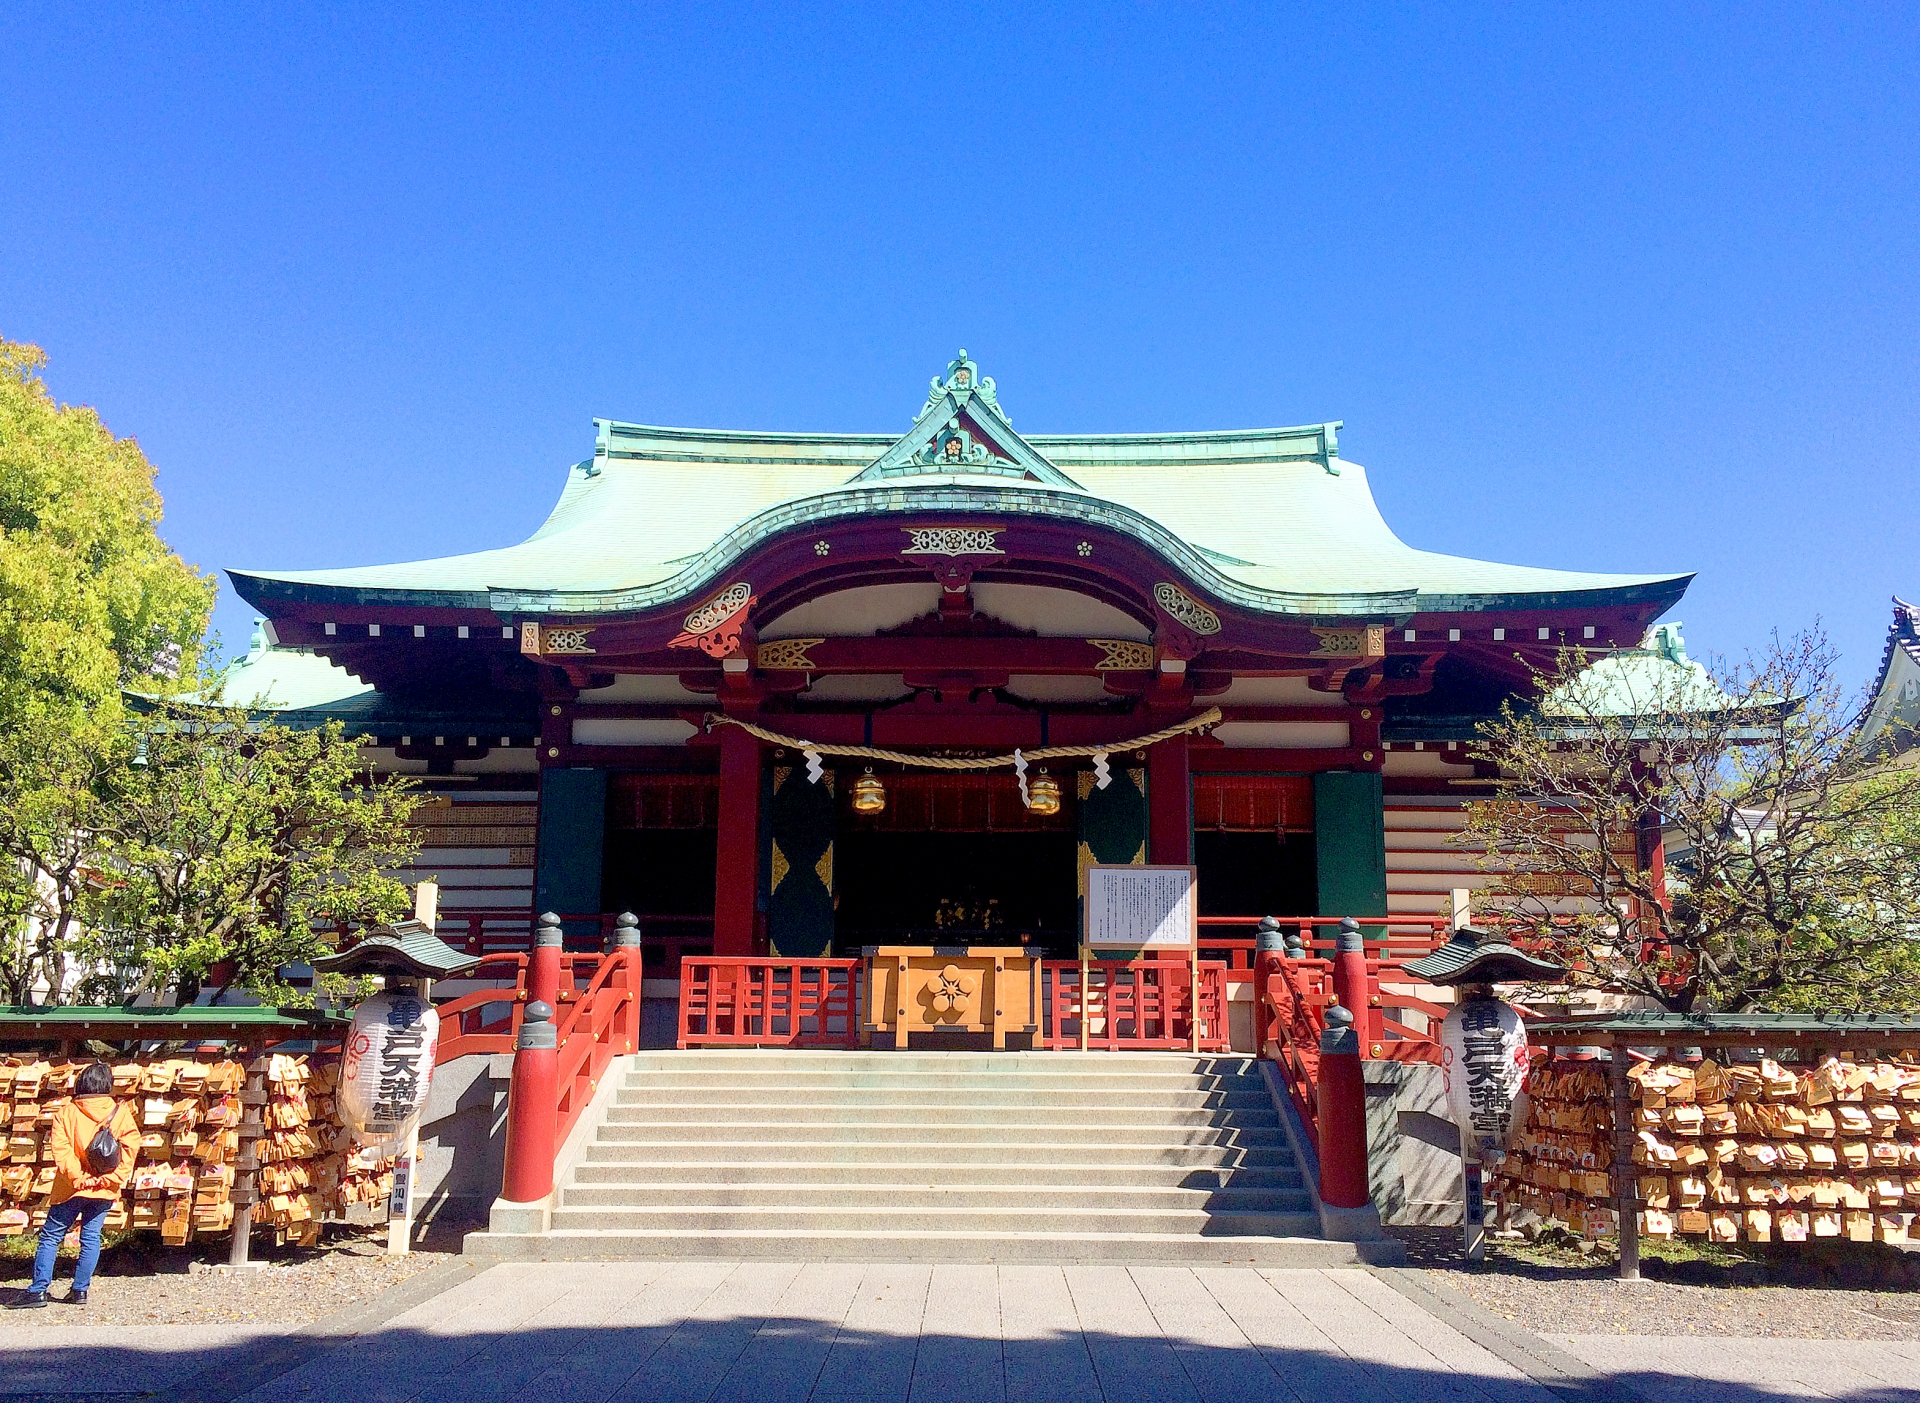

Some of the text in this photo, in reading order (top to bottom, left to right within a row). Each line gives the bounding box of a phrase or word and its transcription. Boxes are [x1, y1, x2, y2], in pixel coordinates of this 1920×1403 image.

[373, 998, 426, 1122] 亀戸天満宮
[1461, 1004, 1512, 1132] 亀戸天満宮
